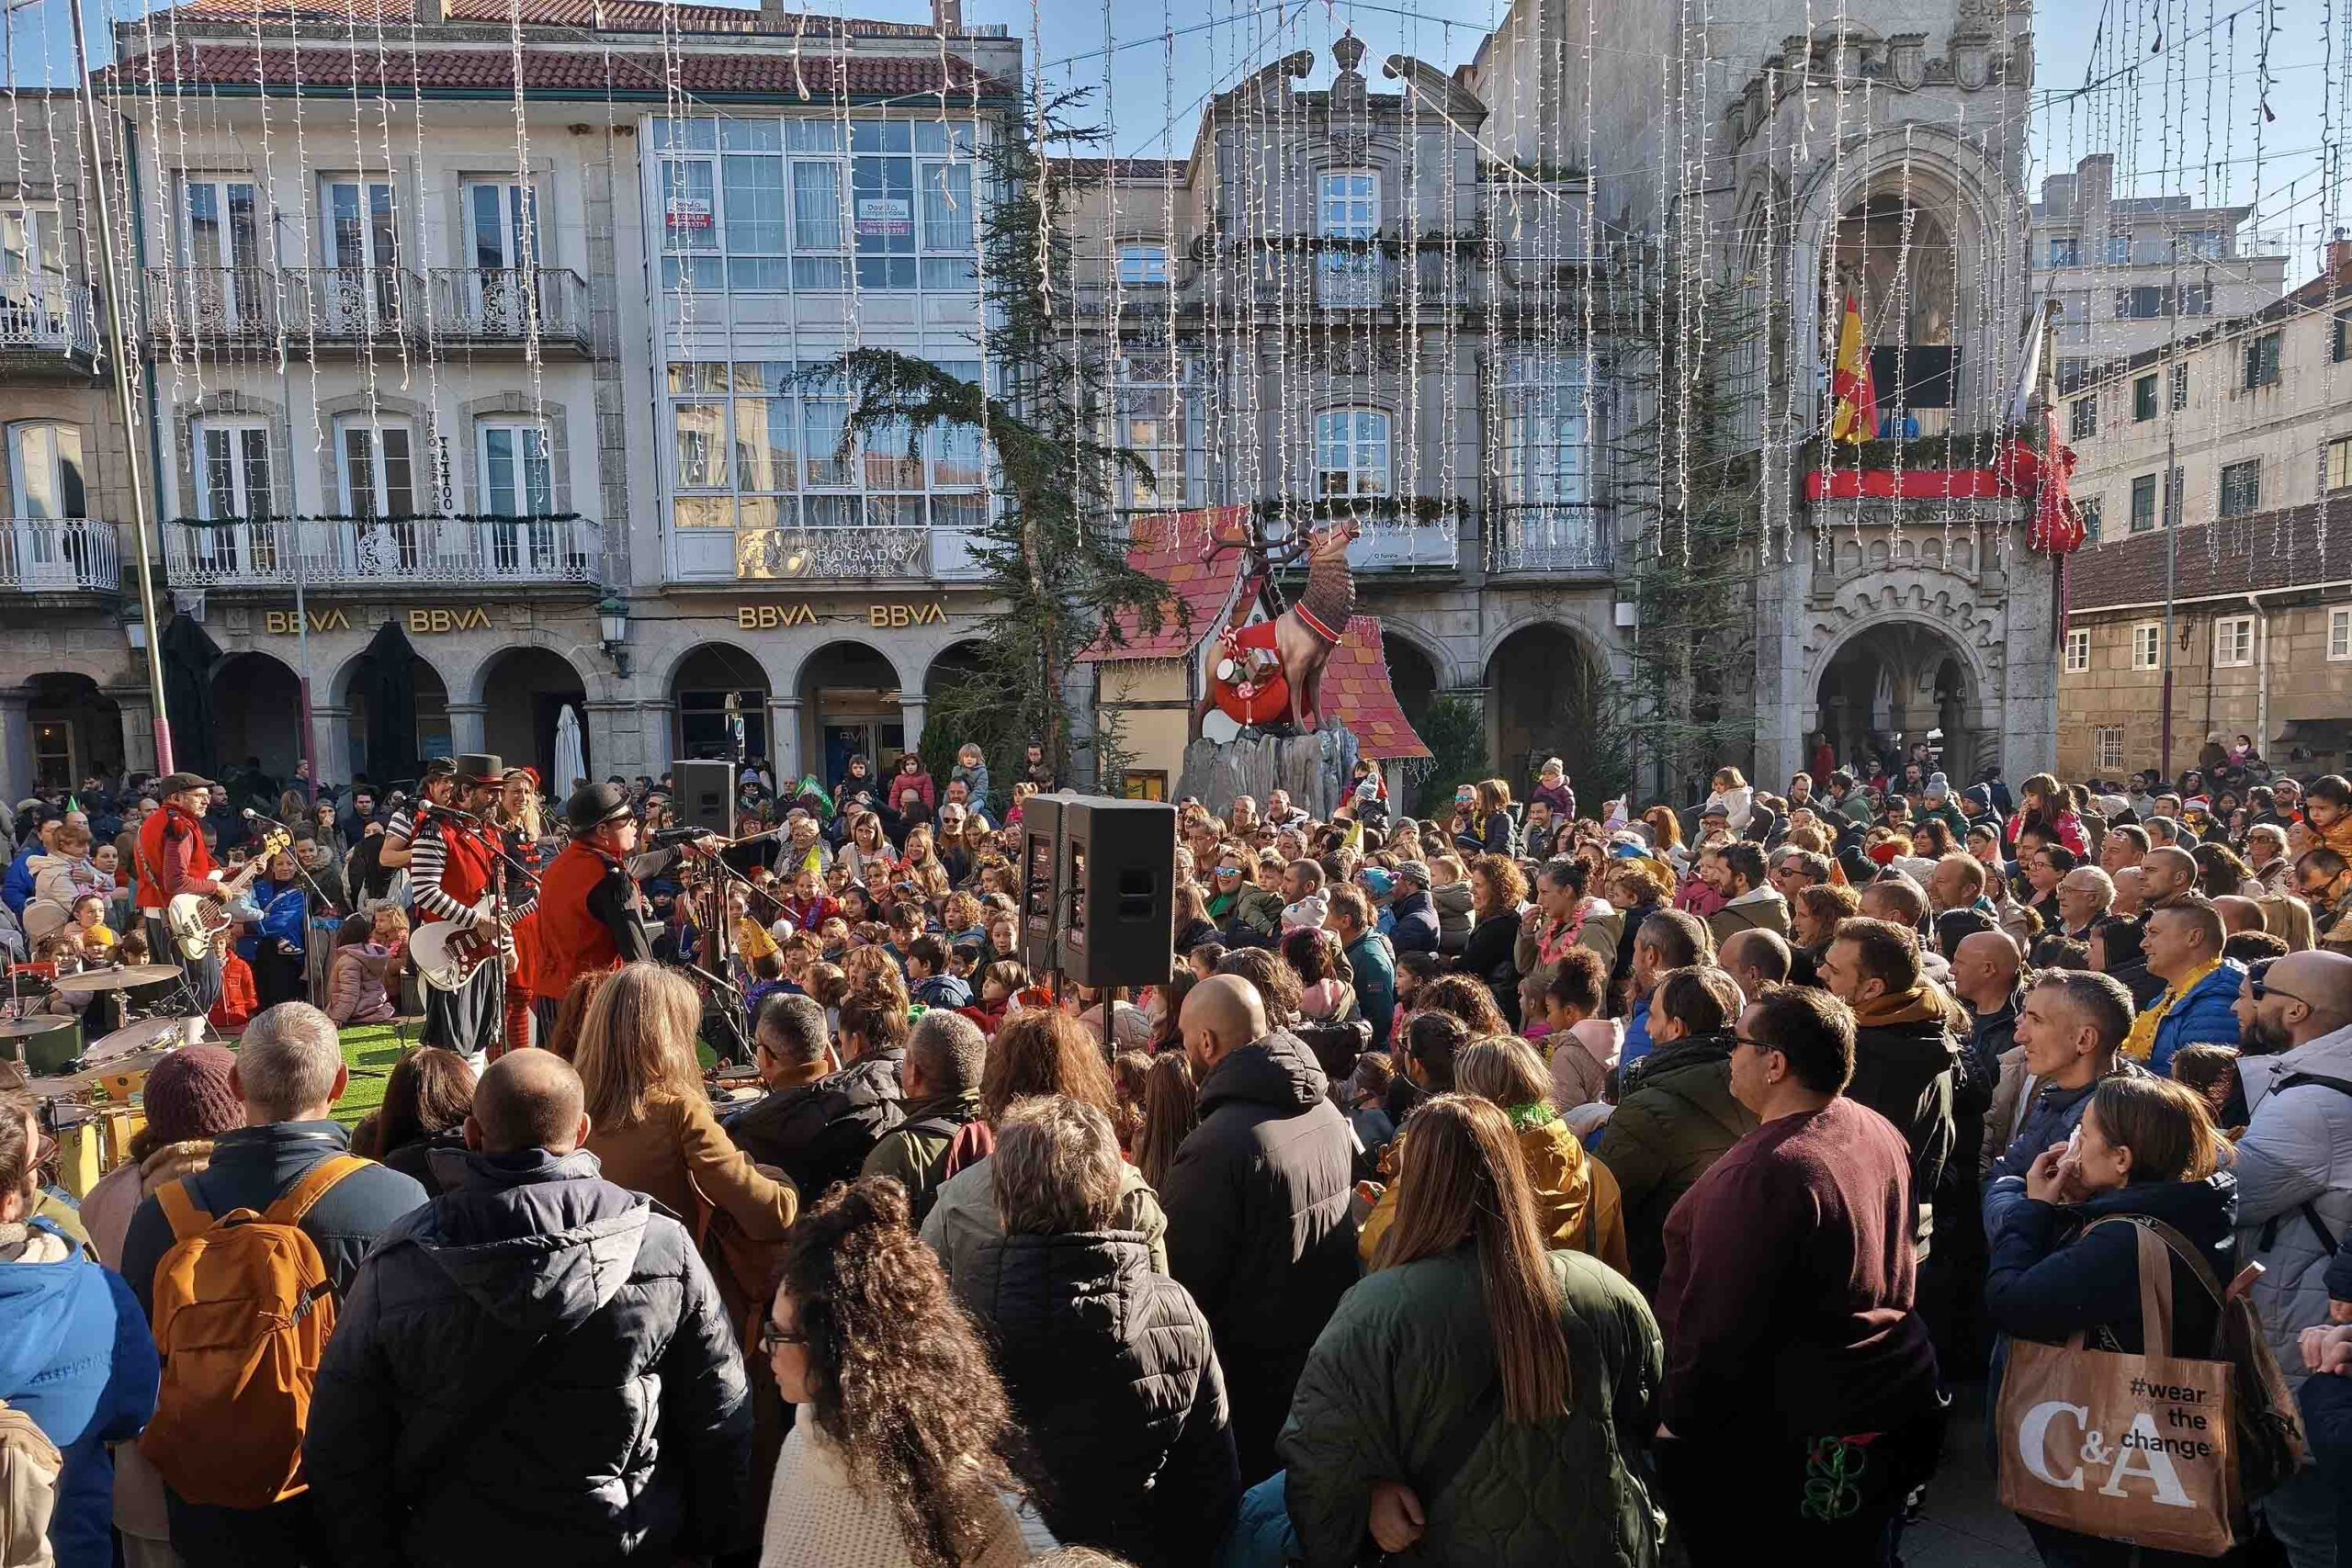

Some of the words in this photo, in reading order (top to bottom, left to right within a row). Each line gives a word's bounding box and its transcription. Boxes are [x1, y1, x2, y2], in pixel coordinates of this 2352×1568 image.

[427, 411, 436, 447] YAGO
[439, 436, 452, 511] TATTOO
[429, 453, 442, 537] FERNANDZ
[1360, 520, 1394, 529] TONIO
[814, 548, 905, 563] BOGADO
[266, 607, 351, 634] BBVA
[408, 606, 492, 633] BBVA
[738, 603, 818, 629] BBVA
[869, 602, 948, 627] BBVA
[2130, 1377, 2207, 1404] #wear
[2167, 1407, 2207, 1430] the
[2018, 1400, 2197, 1509] C&A
[2120, 1428, 2211, 1460] change
